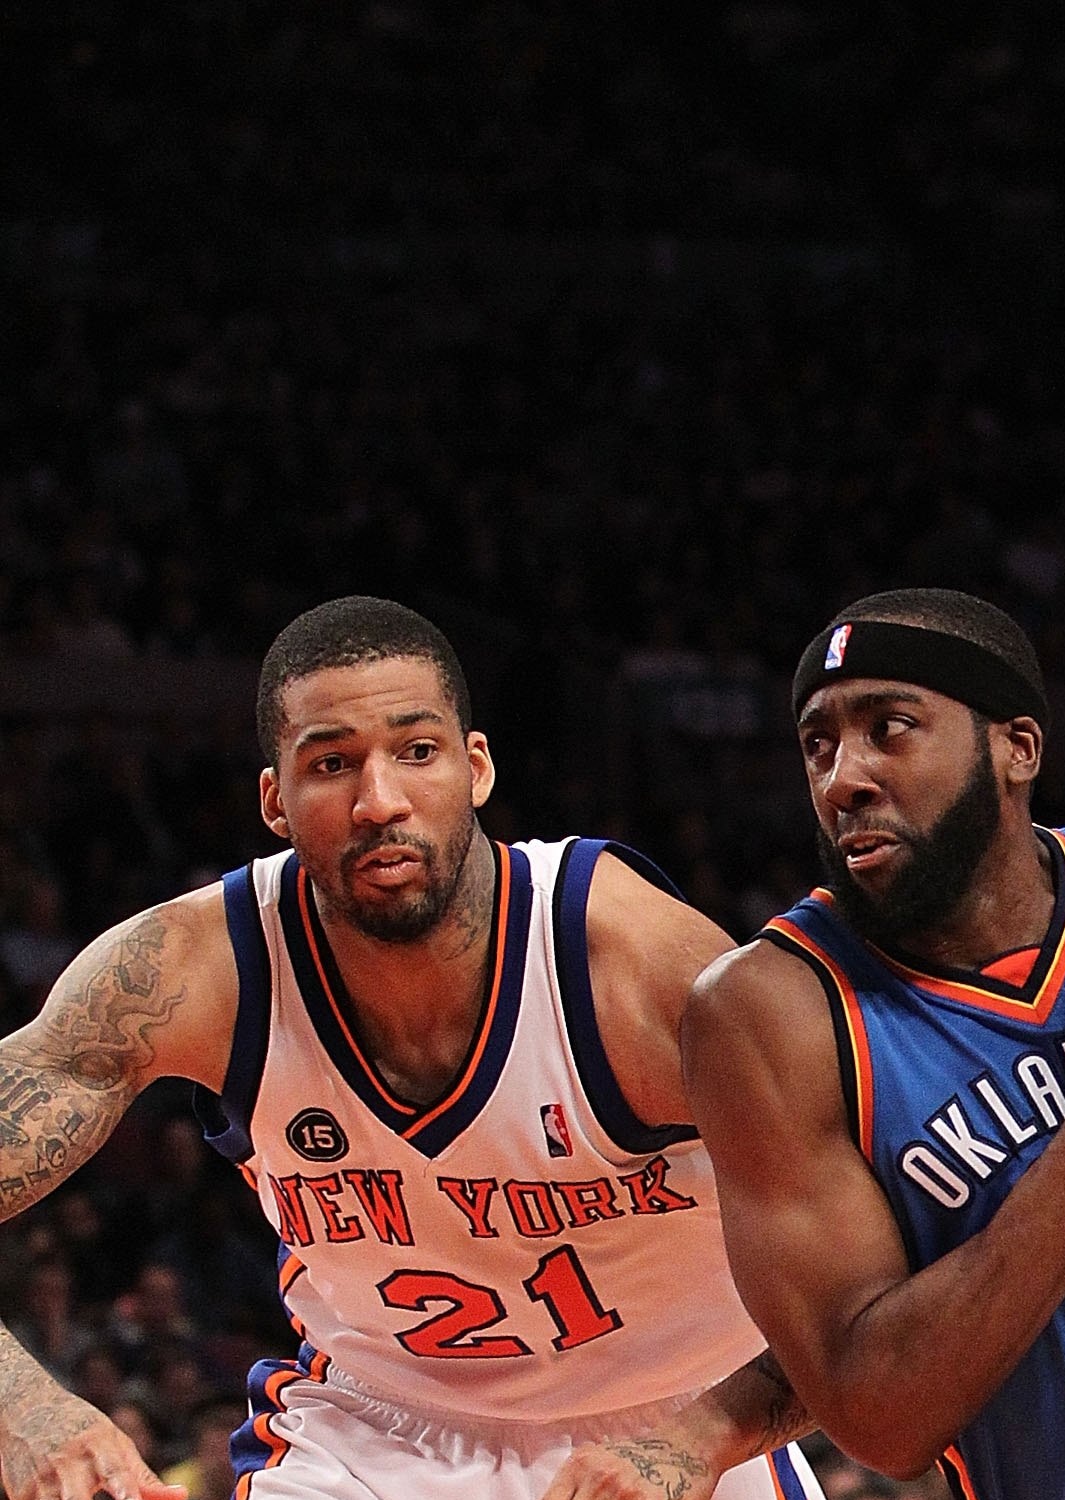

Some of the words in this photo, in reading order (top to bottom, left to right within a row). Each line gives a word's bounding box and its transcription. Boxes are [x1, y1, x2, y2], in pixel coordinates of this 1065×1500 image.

[301, 1125, 335, 1149] 15
[267, 1169, 416, 1247] NEW
[437, 1155, 698, 1238] YORK
[376, 1244, 625, 1358] 21
